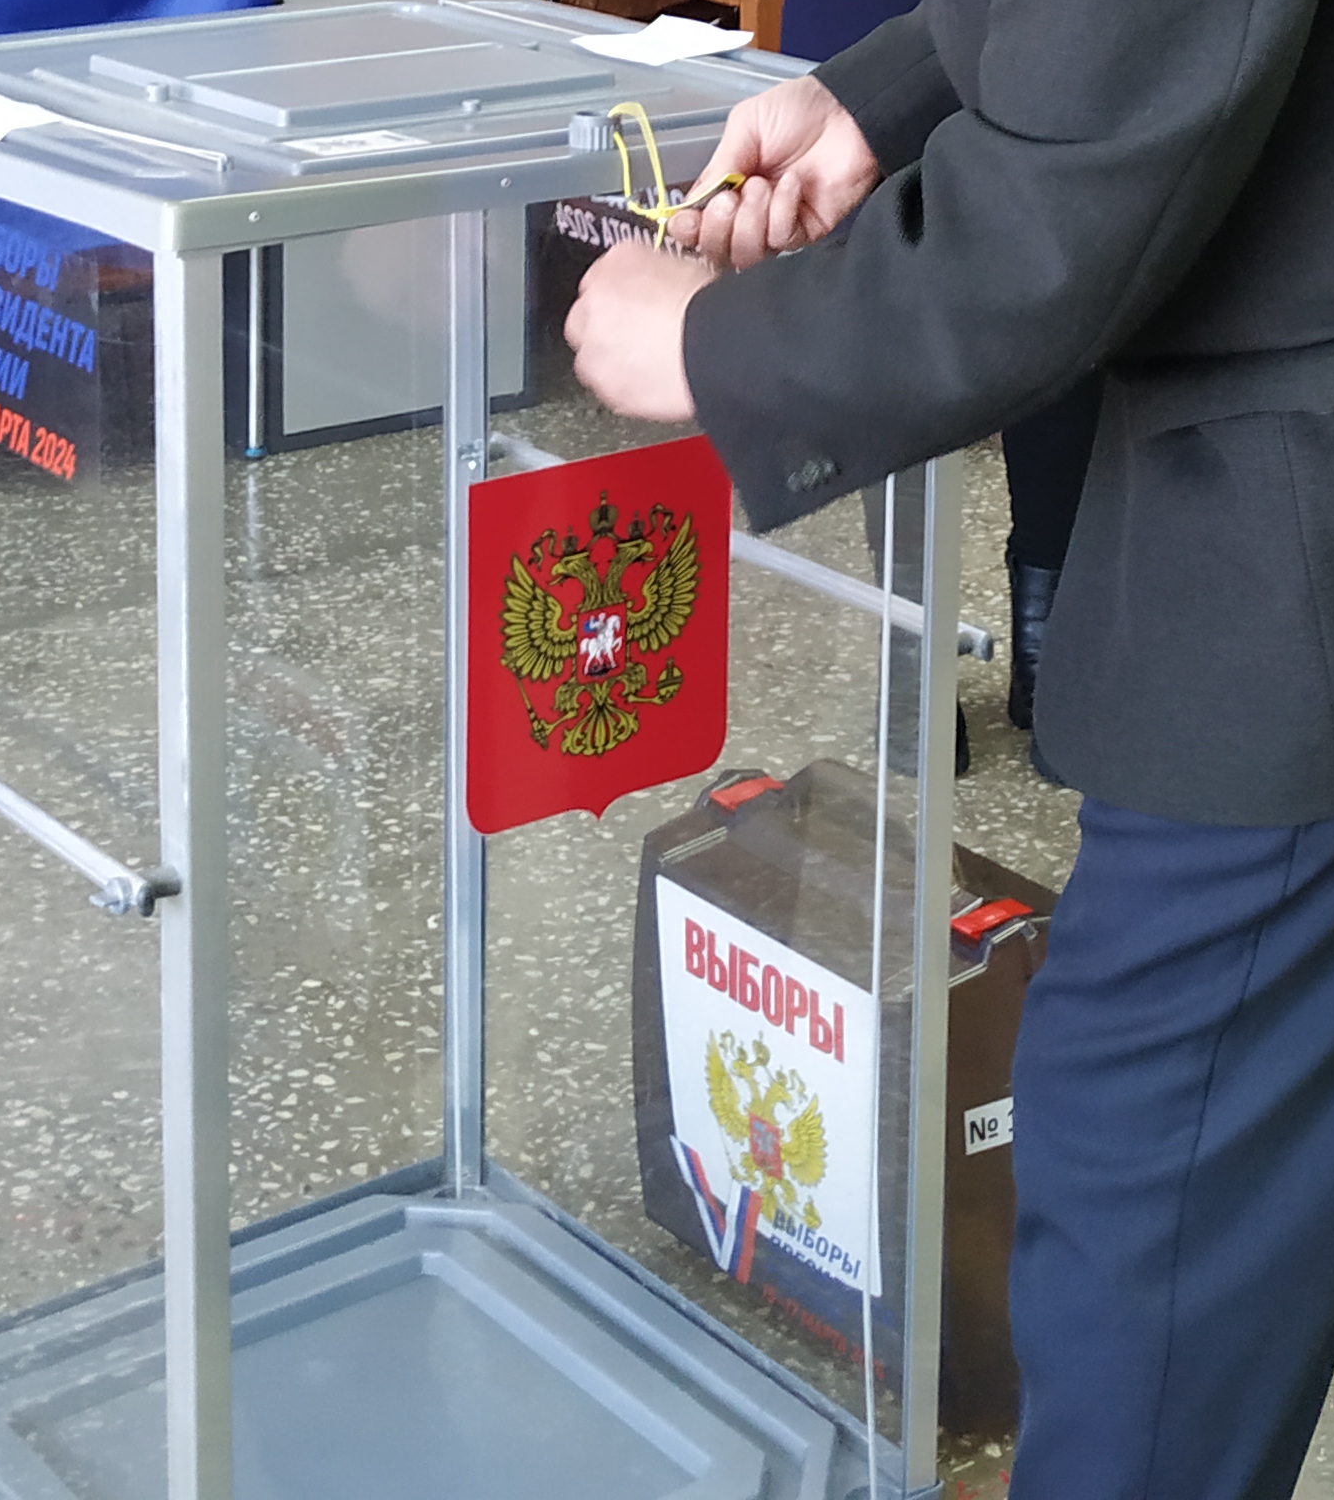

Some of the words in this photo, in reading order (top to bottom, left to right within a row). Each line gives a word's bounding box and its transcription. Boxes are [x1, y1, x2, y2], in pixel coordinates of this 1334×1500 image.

[30, 426, 78, 481] 2024
[684, 917, 845, 1064] ВЫБОРЫ
[970, 1116, 999, 1146] №
[772, 1207, 862, 1280] ВЫБОРЫ
